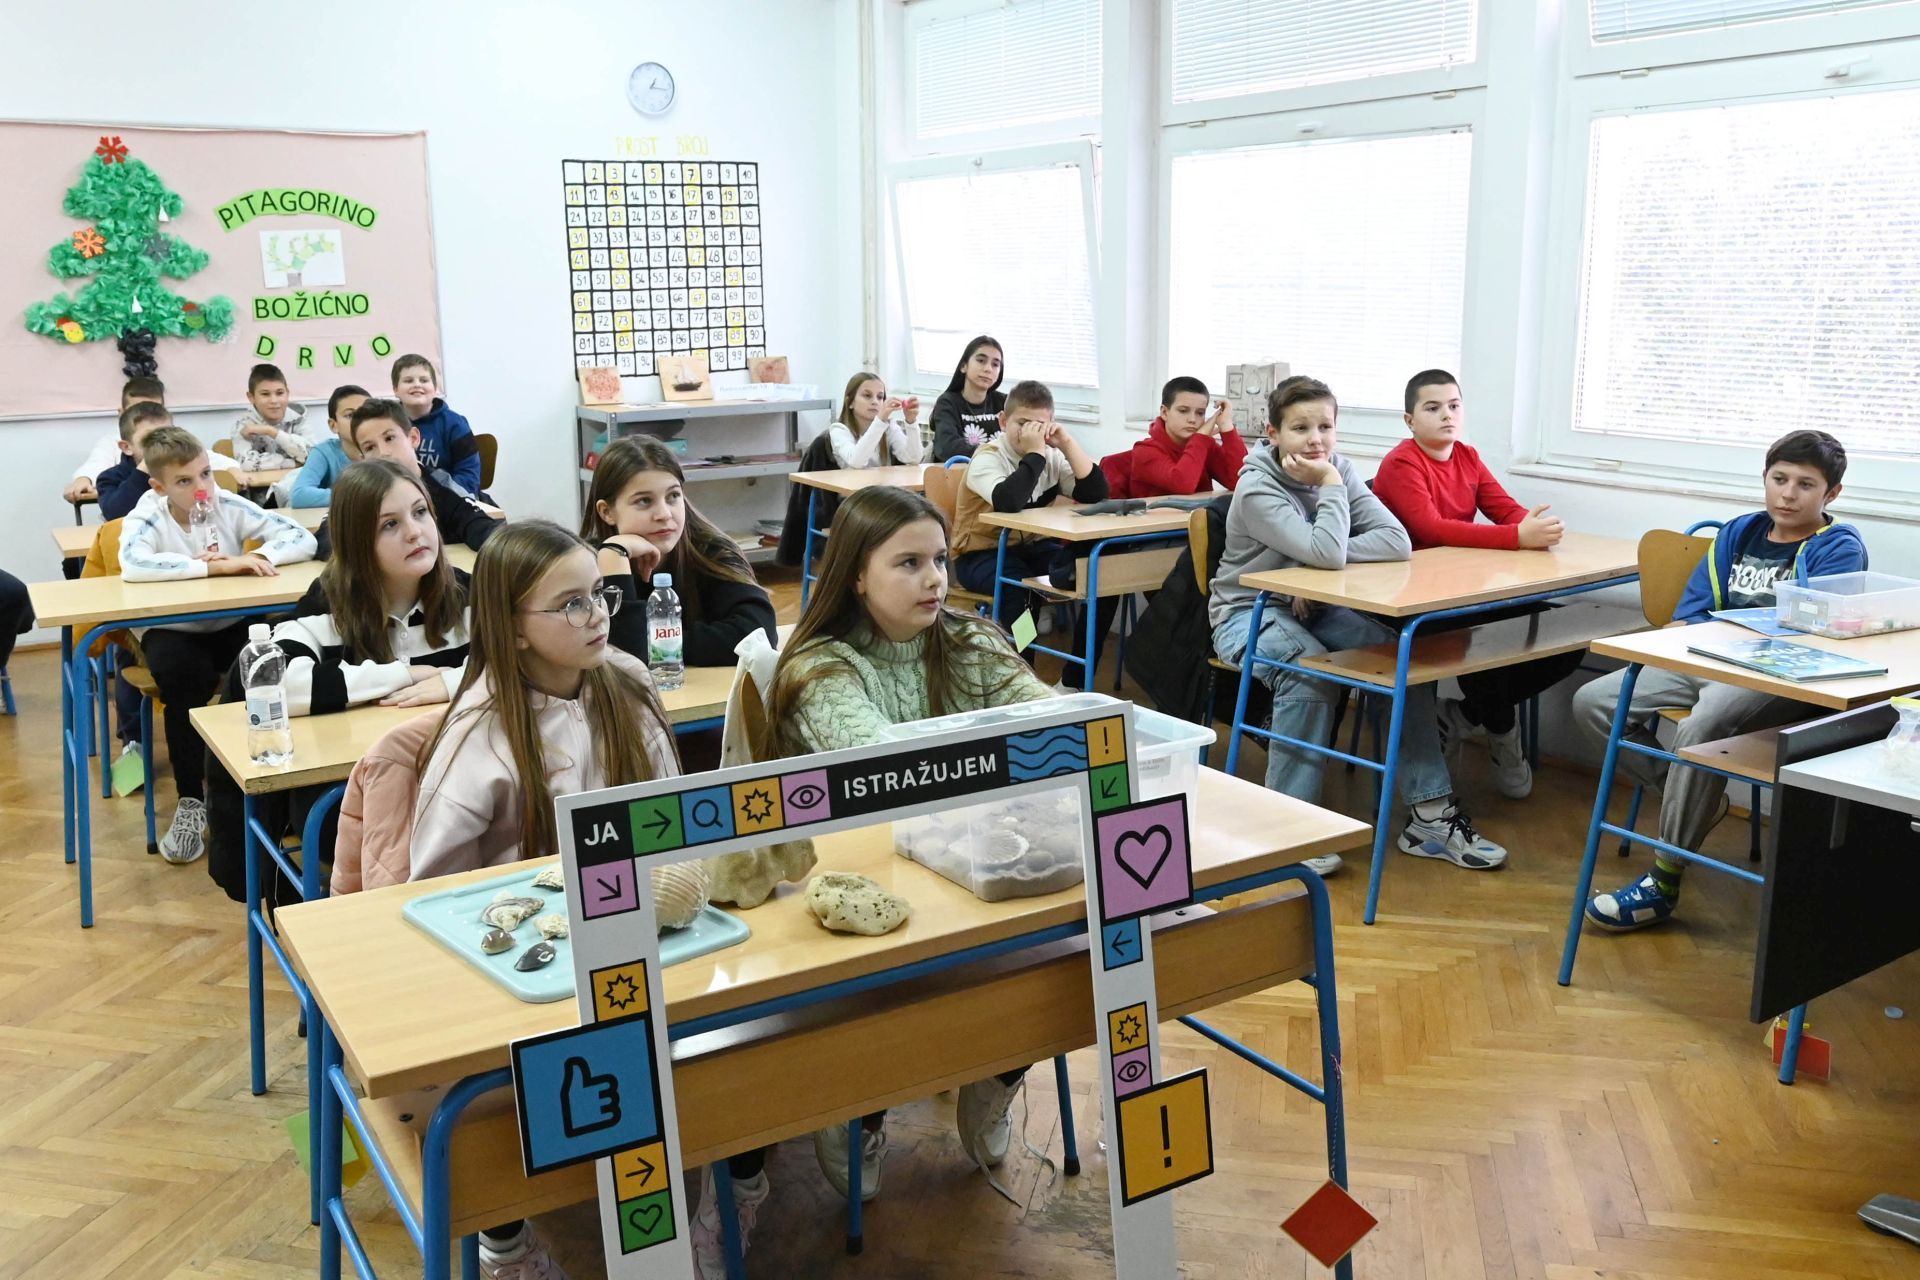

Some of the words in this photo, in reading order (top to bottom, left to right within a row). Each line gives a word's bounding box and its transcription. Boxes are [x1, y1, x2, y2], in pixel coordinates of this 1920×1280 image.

[592, 168, 598, 180] 2
[612, 168, 618, 179] 3
[632, 169, 638, 178] 4
[651, 168, 656, 179] 5
[670, 169, 676, 178] 6
[688, 169, 694, 180] 7
[707, 169, 712, 179] 8
[743, 170, 751, 179] 10
[570, 190, 578, 200] 11
[589, 189, 598, 200] 12
[610, 190, 618, 200] 13
[631, 191, 639, 200] 14
[649, 190, 657, 198] 15
[669, 190, 676, 199] 16
[687, 190, 696, 199] 17
[706, 190, 713, 200] 18
[724, 190, 732, 200] 19
[744, 190, 753, 200] 20
[218, 191, 376, 229] PITAGORINO
[570, 212, 580, 222] 21
[592, 212, 602, 222] 22
[612, 211, 621, 222] 23
[632, 211, 641, 222] 24
[652, 210, 661, 220] 25
[689, 210, 697, 220] 27
[745, 210, 753, 220] 30
[573, 233, 583, 244] 31
[593, 232, 602, 243] 32
[612, 232, 623, 243] 33
[633, 232, 642, 241] 34
[652, 232, 661, 241] 35
[688, 231, 698, 241] 37
[709, 231, 719, 241] 38
[728, 231, 736, 240] 39
[574, 254, 584, 264] 41
[594, 254, 604, 264] 42
[634, 252, 644, 263] 44
[653, 252, 662, 262] 45
[672, 251, 683, 262] 46
[709, 250, 720, 263] 48
[728, 250, 738, 262] 49
[577, 274, 586, 286] 51
[596, 274, 605, 285] 52
[615, 273, 625, 284] 53
[636, 274, 645, 284] 54
[653, 272, 664, 283] 55
[674, 273, 683, 283] 56
[691, 272, 701, 283] 57
[710, 272, 721, 282] 58
[747, 272, 756, 281] 60
[254, 290, 369, 319] BOŽIĆNO
[577, 298, 585, 306] 61
[597, 296, 606, 305] 62
[636, 295, 645, 303] 64
[747, 292, 757, 300] 70
[579, 316, 588, 326] 71
[598, 316, 608, 326] 72
[617, 316, 628, 326] 73
[638, 314, 646, 324] 74
[656, 313, 666, 324] 75
[694, 313, 704, 322] 77
[712, 312, 722, 322] 78
[731, 312, 740, 321] 79
[748, 310, 759, 321] 80
[579, 338, 590, 350] 81
[599, 337, 610, 347] 82
[619, 336, 629, 346] 83
[638, 335, 648, 345] 84
[657, 335, 667, 345] 85
[676, 334, 686, 344] 86
[694, 332, 704, 343] 87
[713, 331, 723, 341] 88
[750, 330, 759, 340] 90
[715, 352, 724, 363] 98
[732, 350, 742, 360] 99
[584, 820, 619, 847] JA
[843, 753, 998, 800] ISTRAŽUJEM
